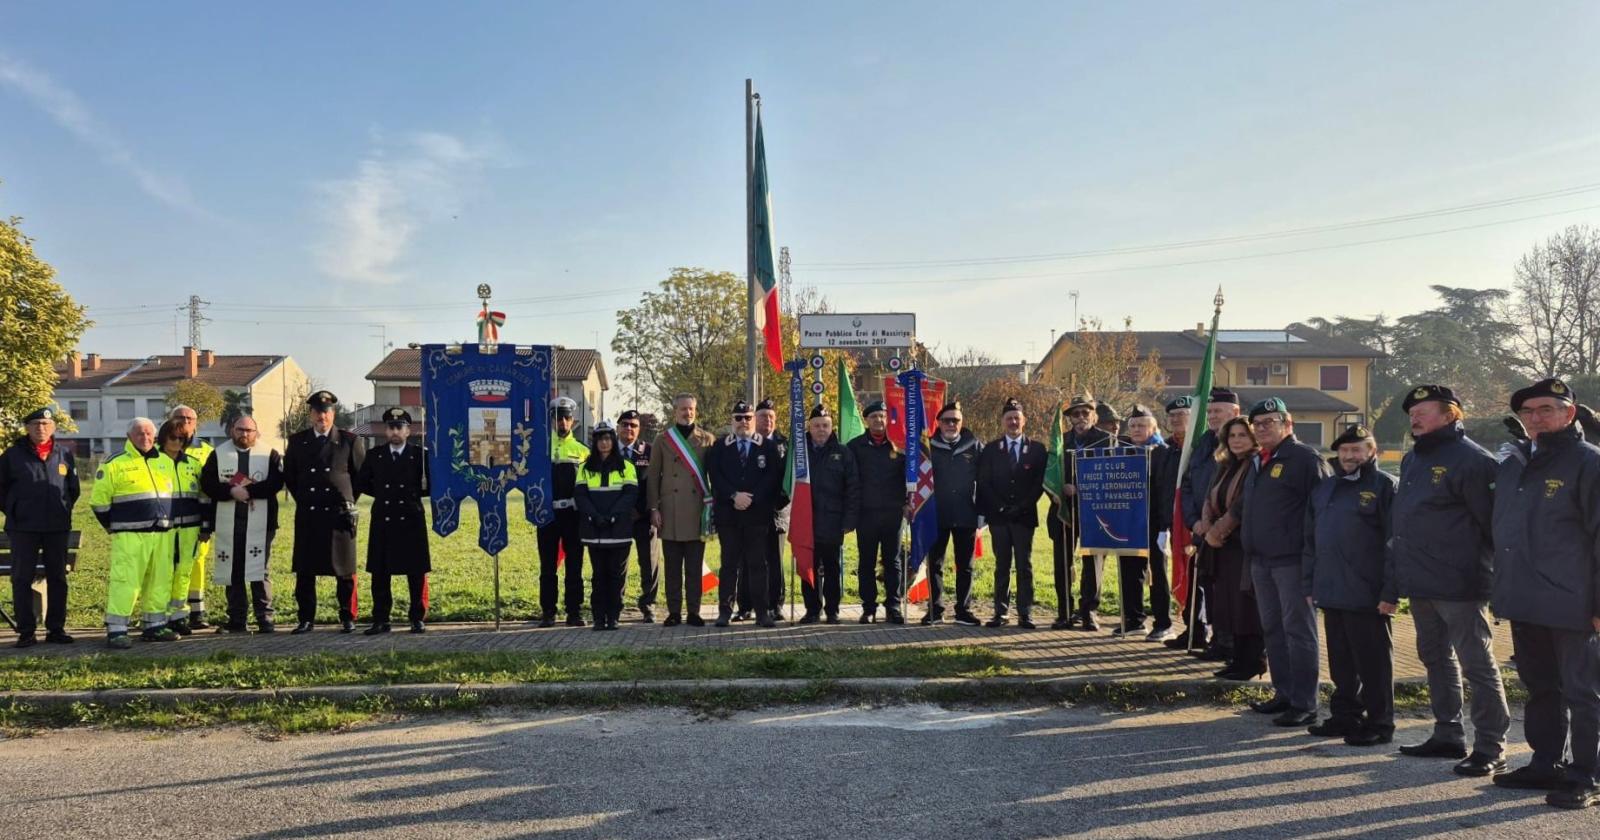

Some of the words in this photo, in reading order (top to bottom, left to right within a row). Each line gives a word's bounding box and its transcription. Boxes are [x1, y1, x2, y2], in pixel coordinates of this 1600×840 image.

[1105, 462, 1126, 470] CLUB
[1105, 471, 1140, 480] TRICOLORI
[1101, 481, 1146, 490] AERONAUTICA
[1091, 502, 1130, 510] CAVARZERE
